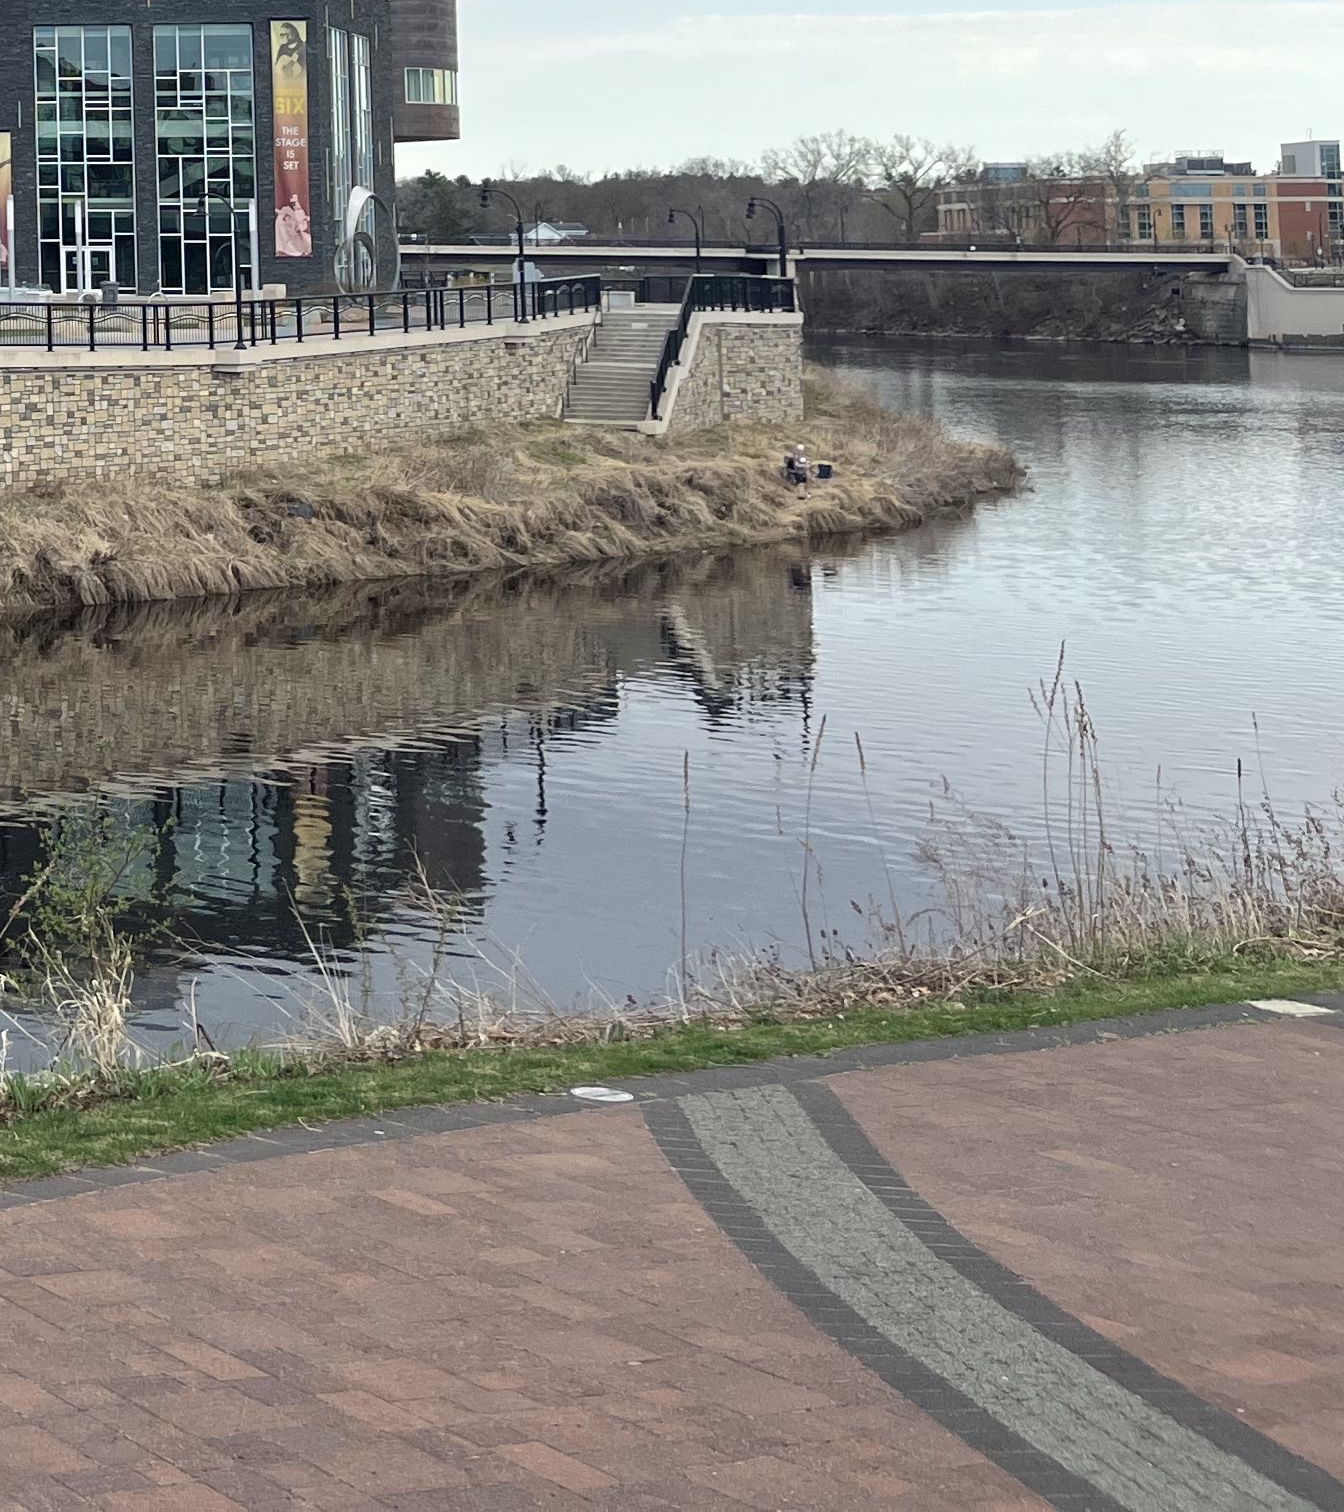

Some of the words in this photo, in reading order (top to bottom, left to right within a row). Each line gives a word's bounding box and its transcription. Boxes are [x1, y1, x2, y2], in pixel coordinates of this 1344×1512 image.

[276, 97, 304, 114] SIX
[281, 126, 299, 136] THE
[275, 137, 307, 147] STAGE
[286, 149, 295, 159] IS
[283, 160, 300, 170] SET
